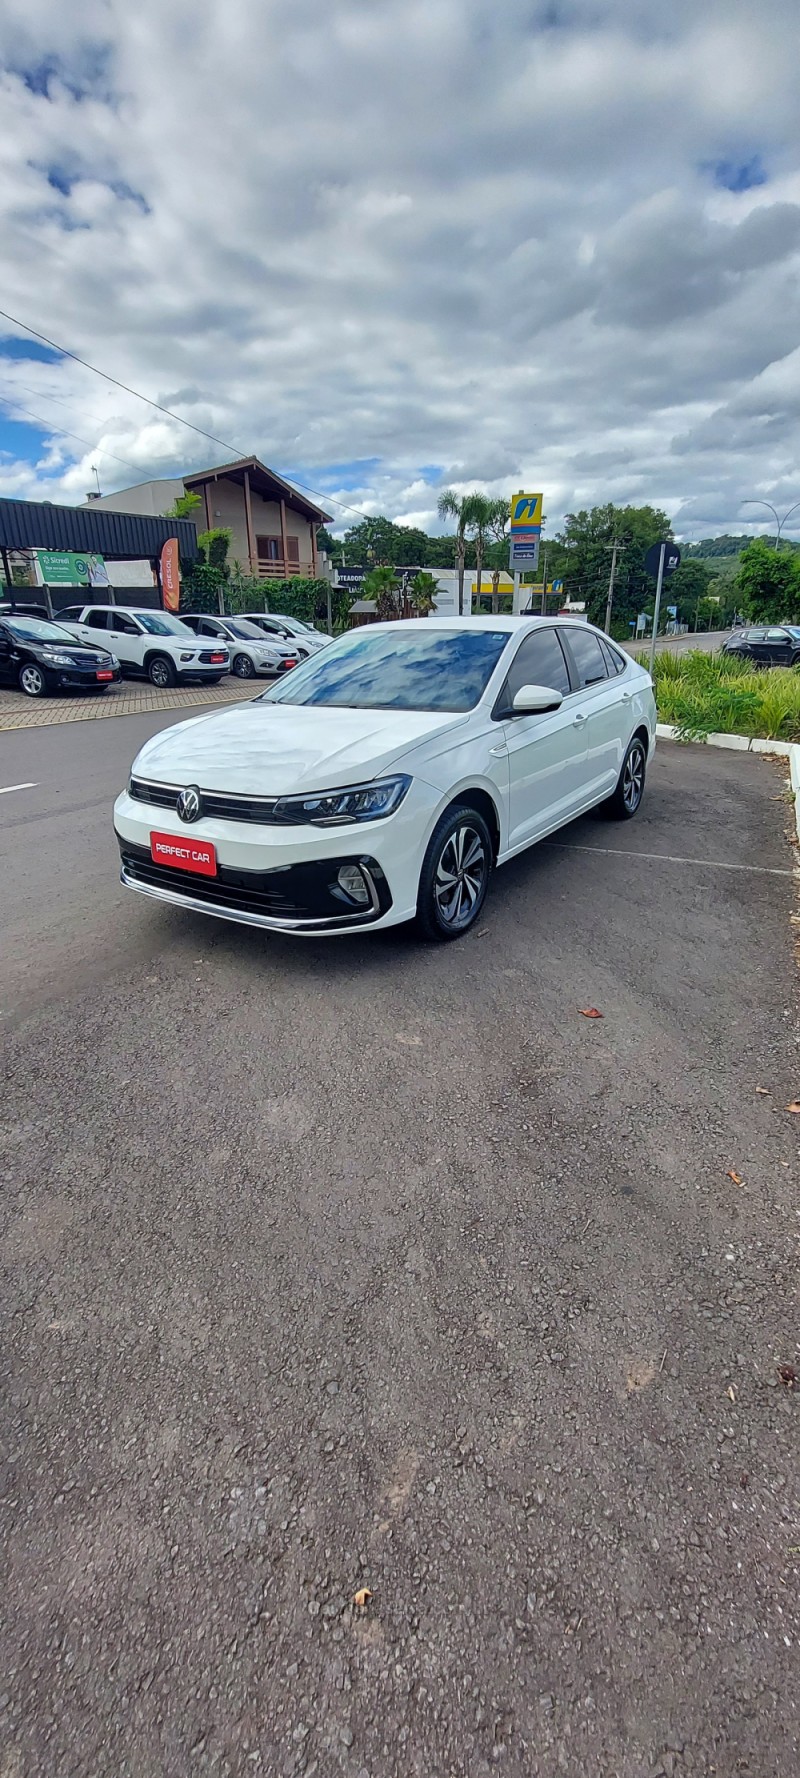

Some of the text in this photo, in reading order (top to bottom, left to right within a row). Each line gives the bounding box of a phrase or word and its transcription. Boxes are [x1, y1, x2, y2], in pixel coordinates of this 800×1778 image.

[50, 556, 70, 565] Sicredi
[155, 843, 210, 864] PERFECT CAR
